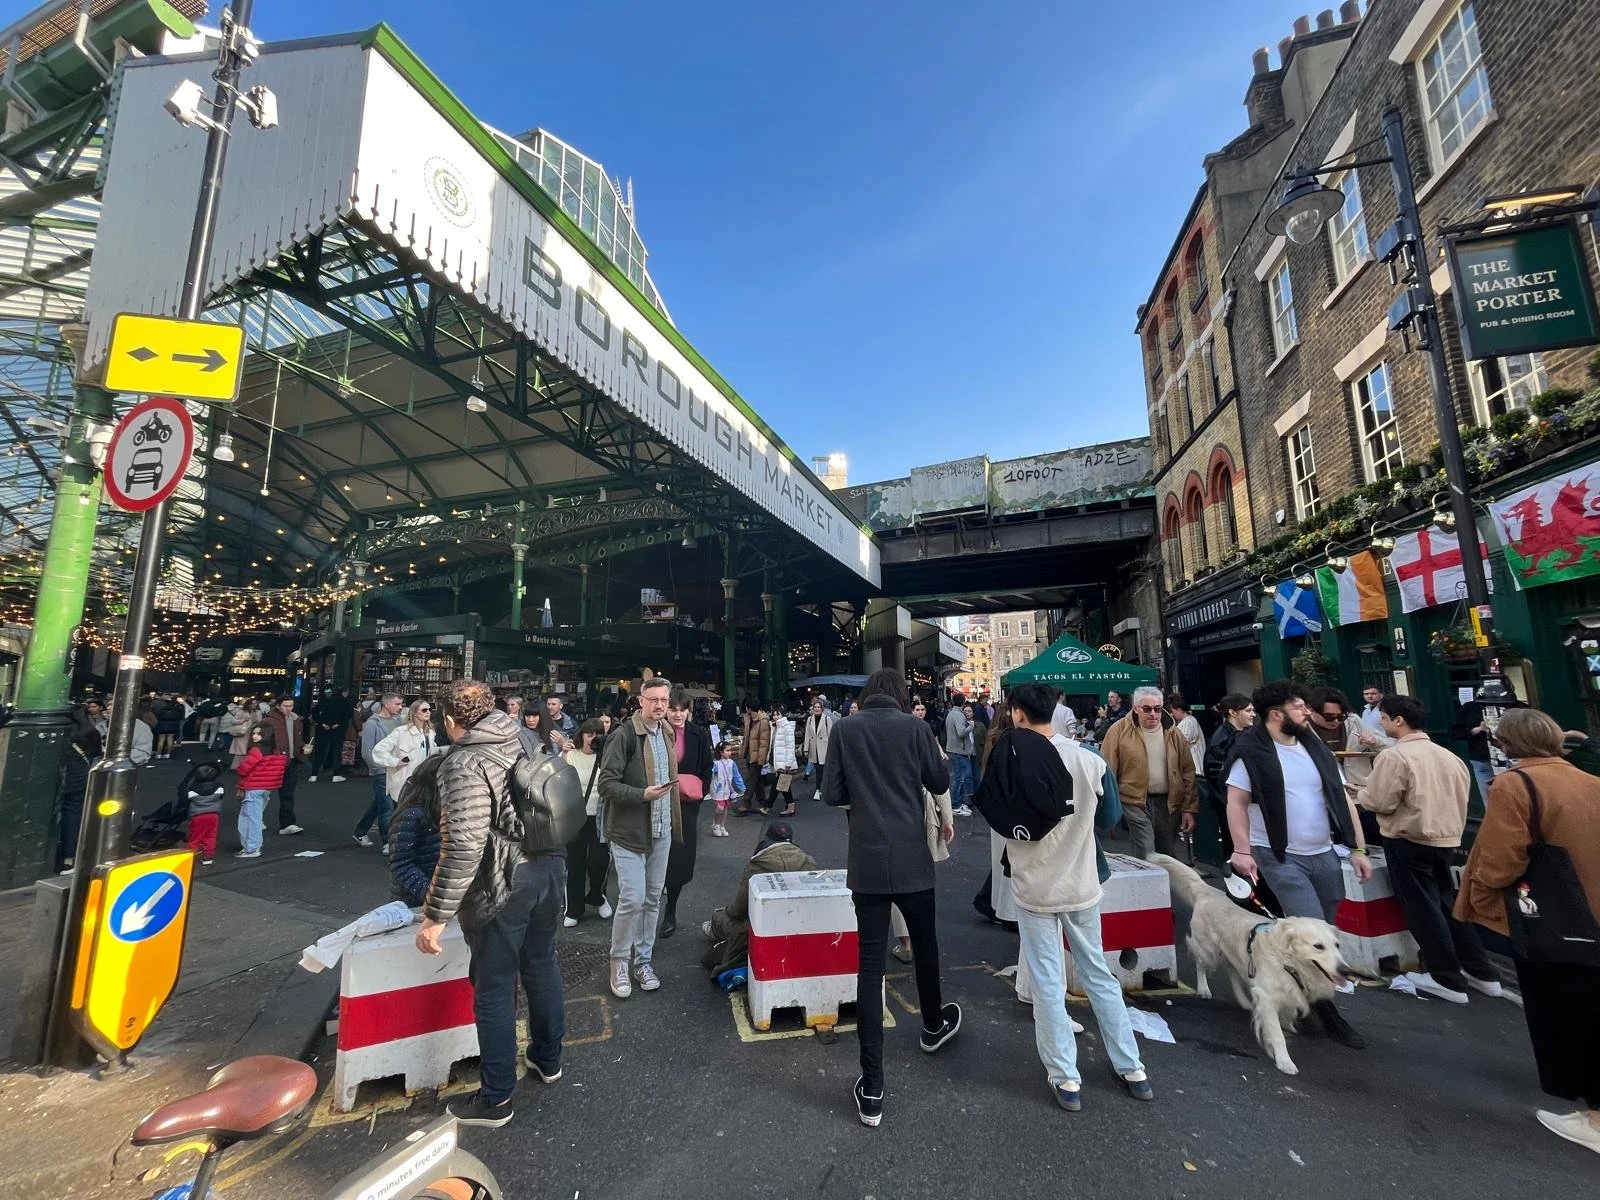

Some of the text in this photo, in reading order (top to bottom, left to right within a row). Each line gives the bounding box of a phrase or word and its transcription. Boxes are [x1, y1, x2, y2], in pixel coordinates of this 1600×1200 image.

[1468, 259, 1511, 276] THE
[1472, 270, 1557, 294] MARKET
[1476, 288, 1563, 312] PORTER
[1480, 309, 1575, 329] PUB & DINING ROOM
[521, 234, 833, 535] BOROUGH MARKET
[1084, 451, 1139, 468] ADZE
[1003, 466, 1063, 483] 10FOOT
[525, 634, 531, 642] Le
[233, 667, 272, 675] FURNESS
[377, 1168, 413, 1198] minutes
[415, 1155, 431, 1170] free
[432, 1140, 450, 1157] daily
